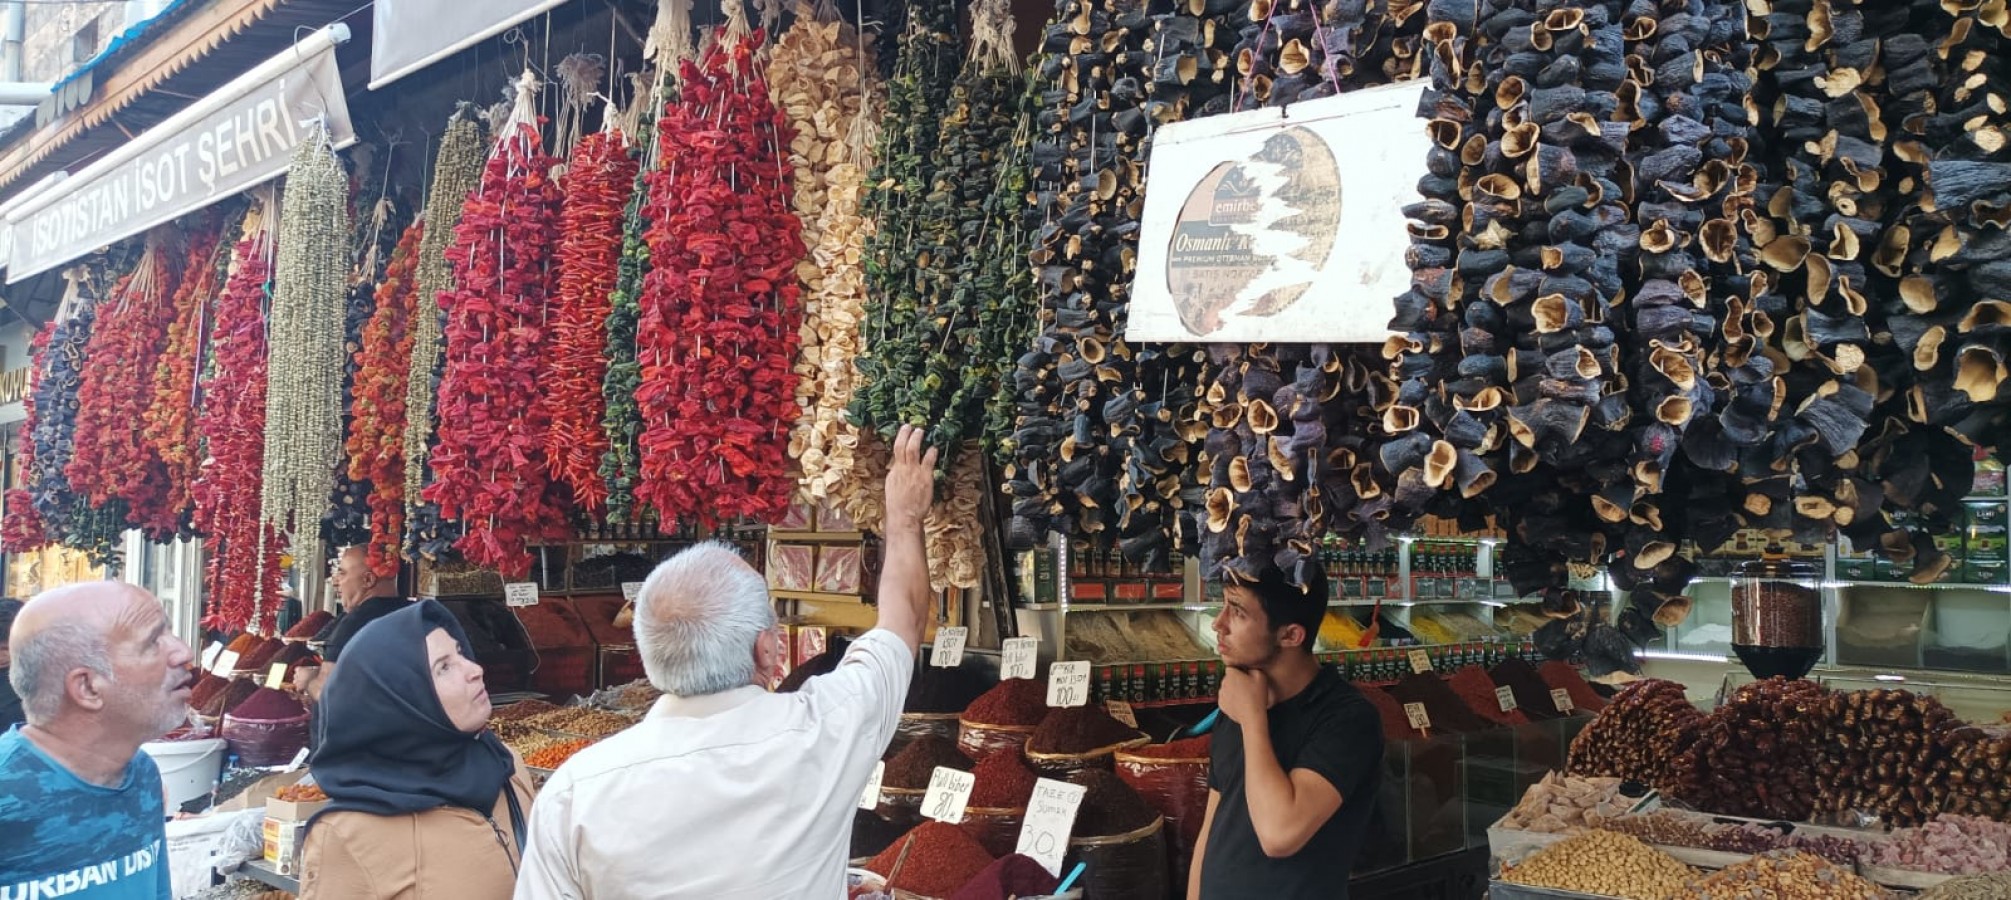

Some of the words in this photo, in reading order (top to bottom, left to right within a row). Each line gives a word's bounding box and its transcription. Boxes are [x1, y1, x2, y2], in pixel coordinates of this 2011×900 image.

[135, 145, 190, 212] İSOT
[198, 79, 297, 196] ŞEHRİ
[1022, 823, 1055, 855] 30
[0, 860, 118, 900] URBAN
